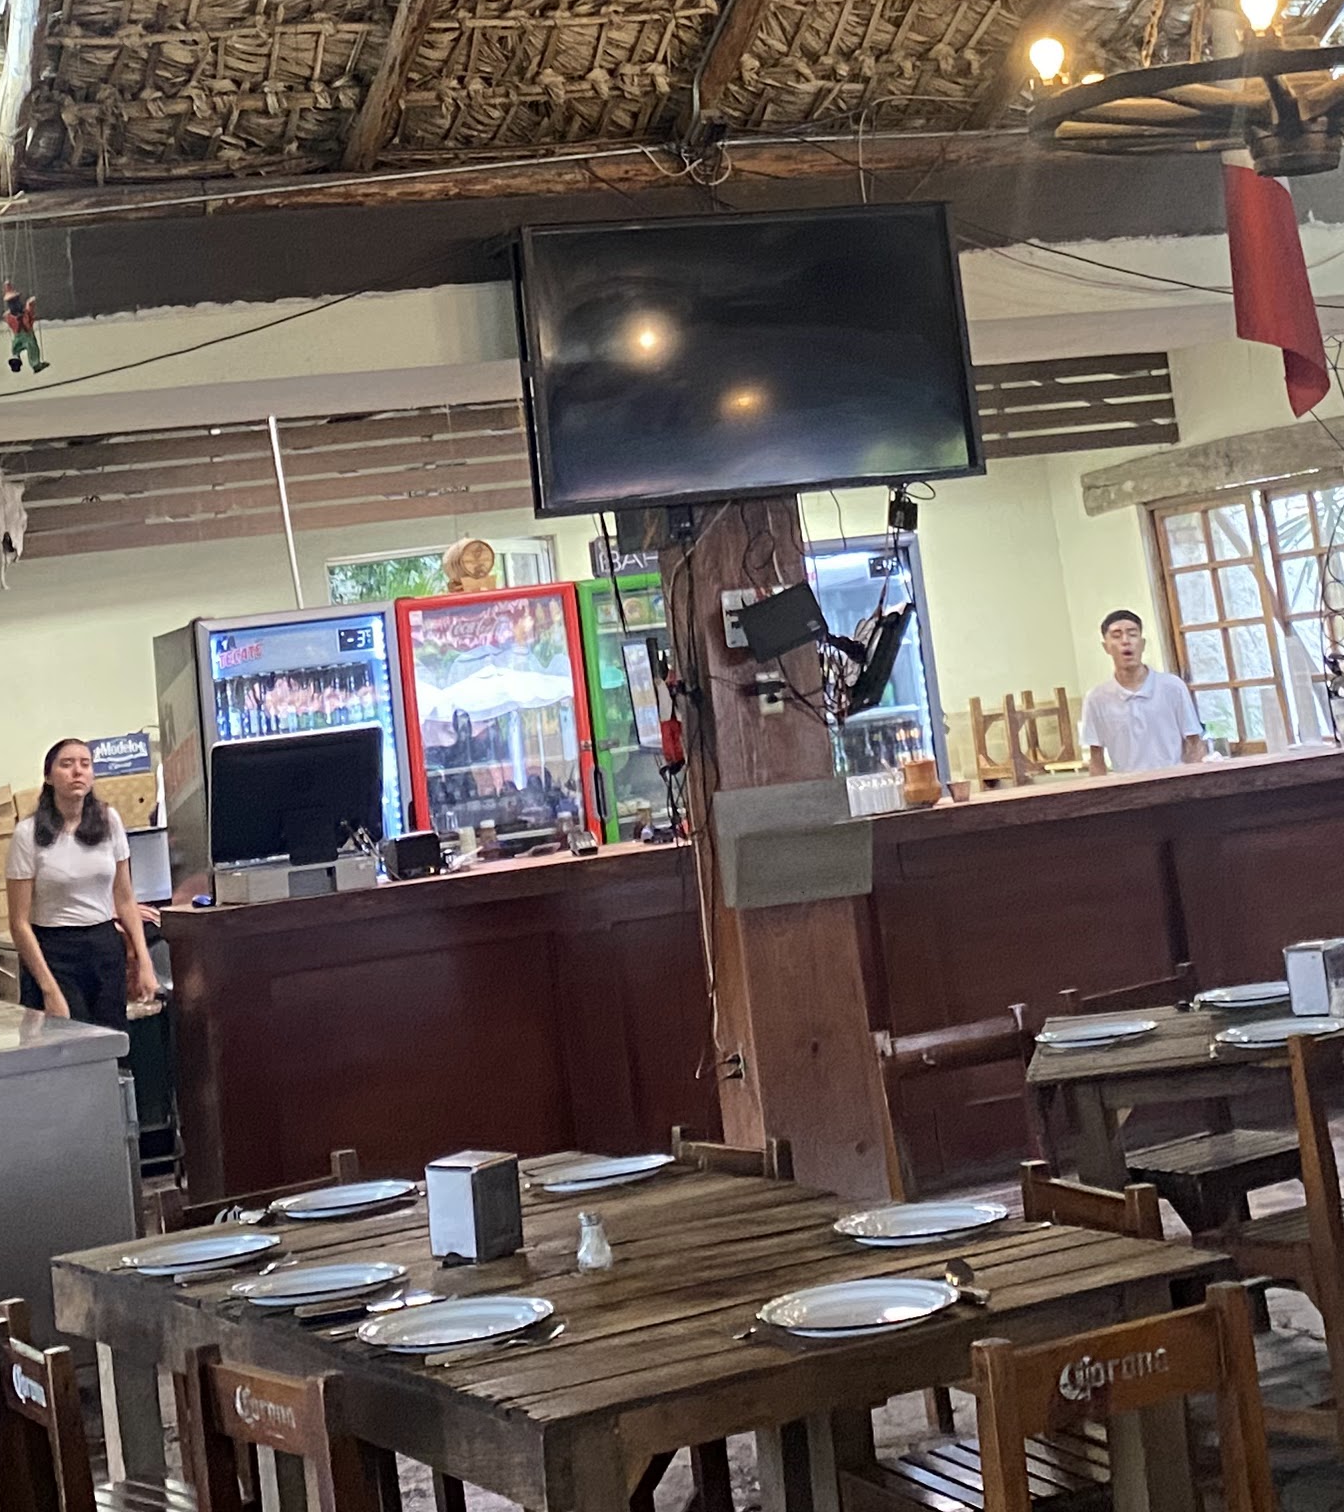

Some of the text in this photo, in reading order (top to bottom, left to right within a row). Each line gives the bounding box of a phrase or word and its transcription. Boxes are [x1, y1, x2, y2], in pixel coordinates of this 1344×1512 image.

[218, 643, 264, 670] TECATE
[99, 740, 139, 757] Modelo
[1059, 1348, 1168, 1401] Corona
